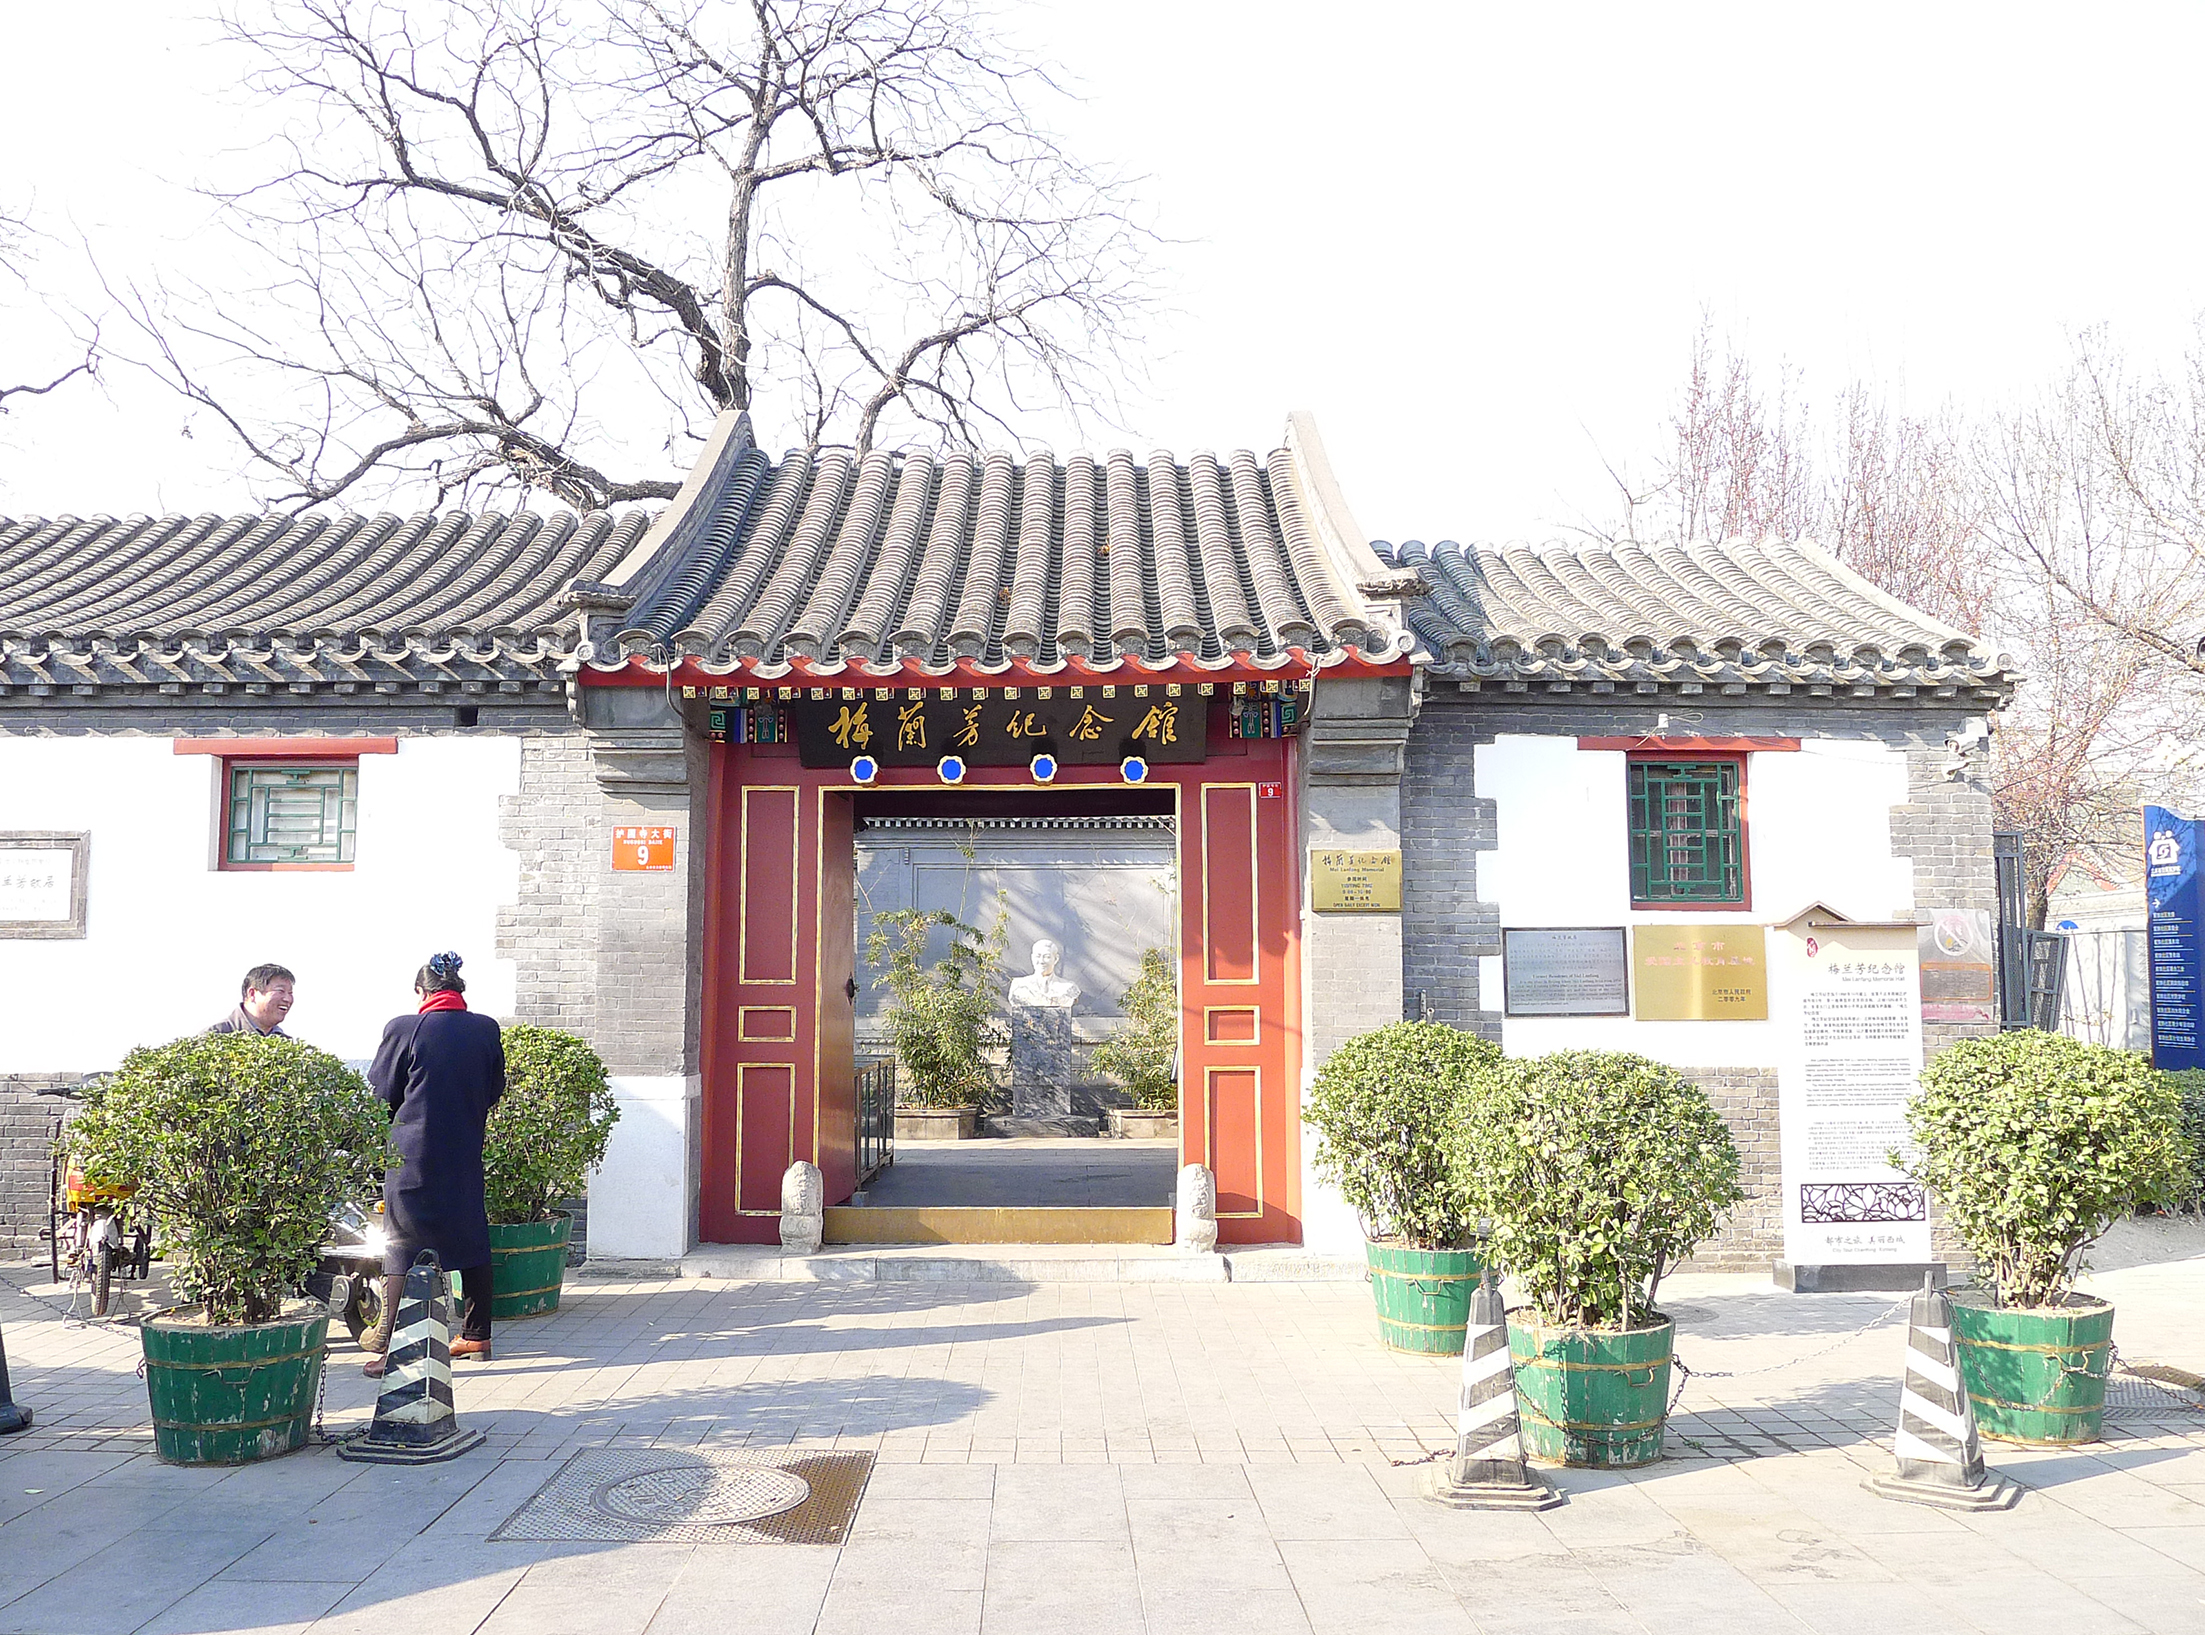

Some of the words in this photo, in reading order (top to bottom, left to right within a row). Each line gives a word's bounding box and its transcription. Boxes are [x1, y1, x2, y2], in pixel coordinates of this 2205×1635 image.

[1267, 788, 1274, 796] 9
[615, 829, 672, 838] 护国寺大街
[637, 845, 649, 865] 9
[1673, 941, 1726, 951] 北京市
[1828, 962, 1906, 976] 梅兰芳纪念馆
